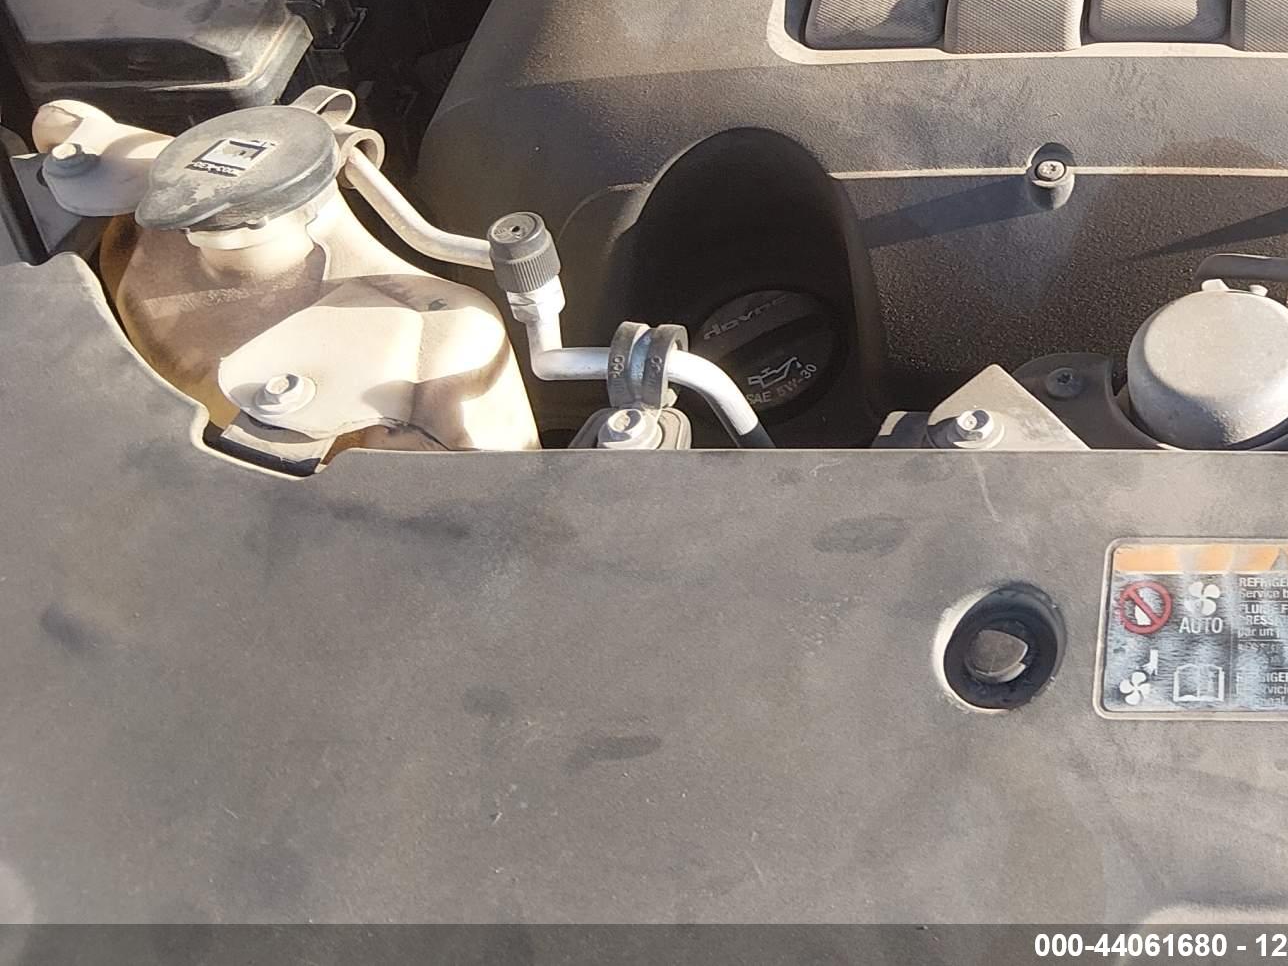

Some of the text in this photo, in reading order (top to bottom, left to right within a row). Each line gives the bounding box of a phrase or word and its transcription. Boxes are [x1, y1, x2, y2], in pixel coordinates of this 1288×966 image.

[776, 363, 817, 397] 5W-30
[1179, 617, 1224, 634] AUTO
[1259, 628, 1274, 637] un
